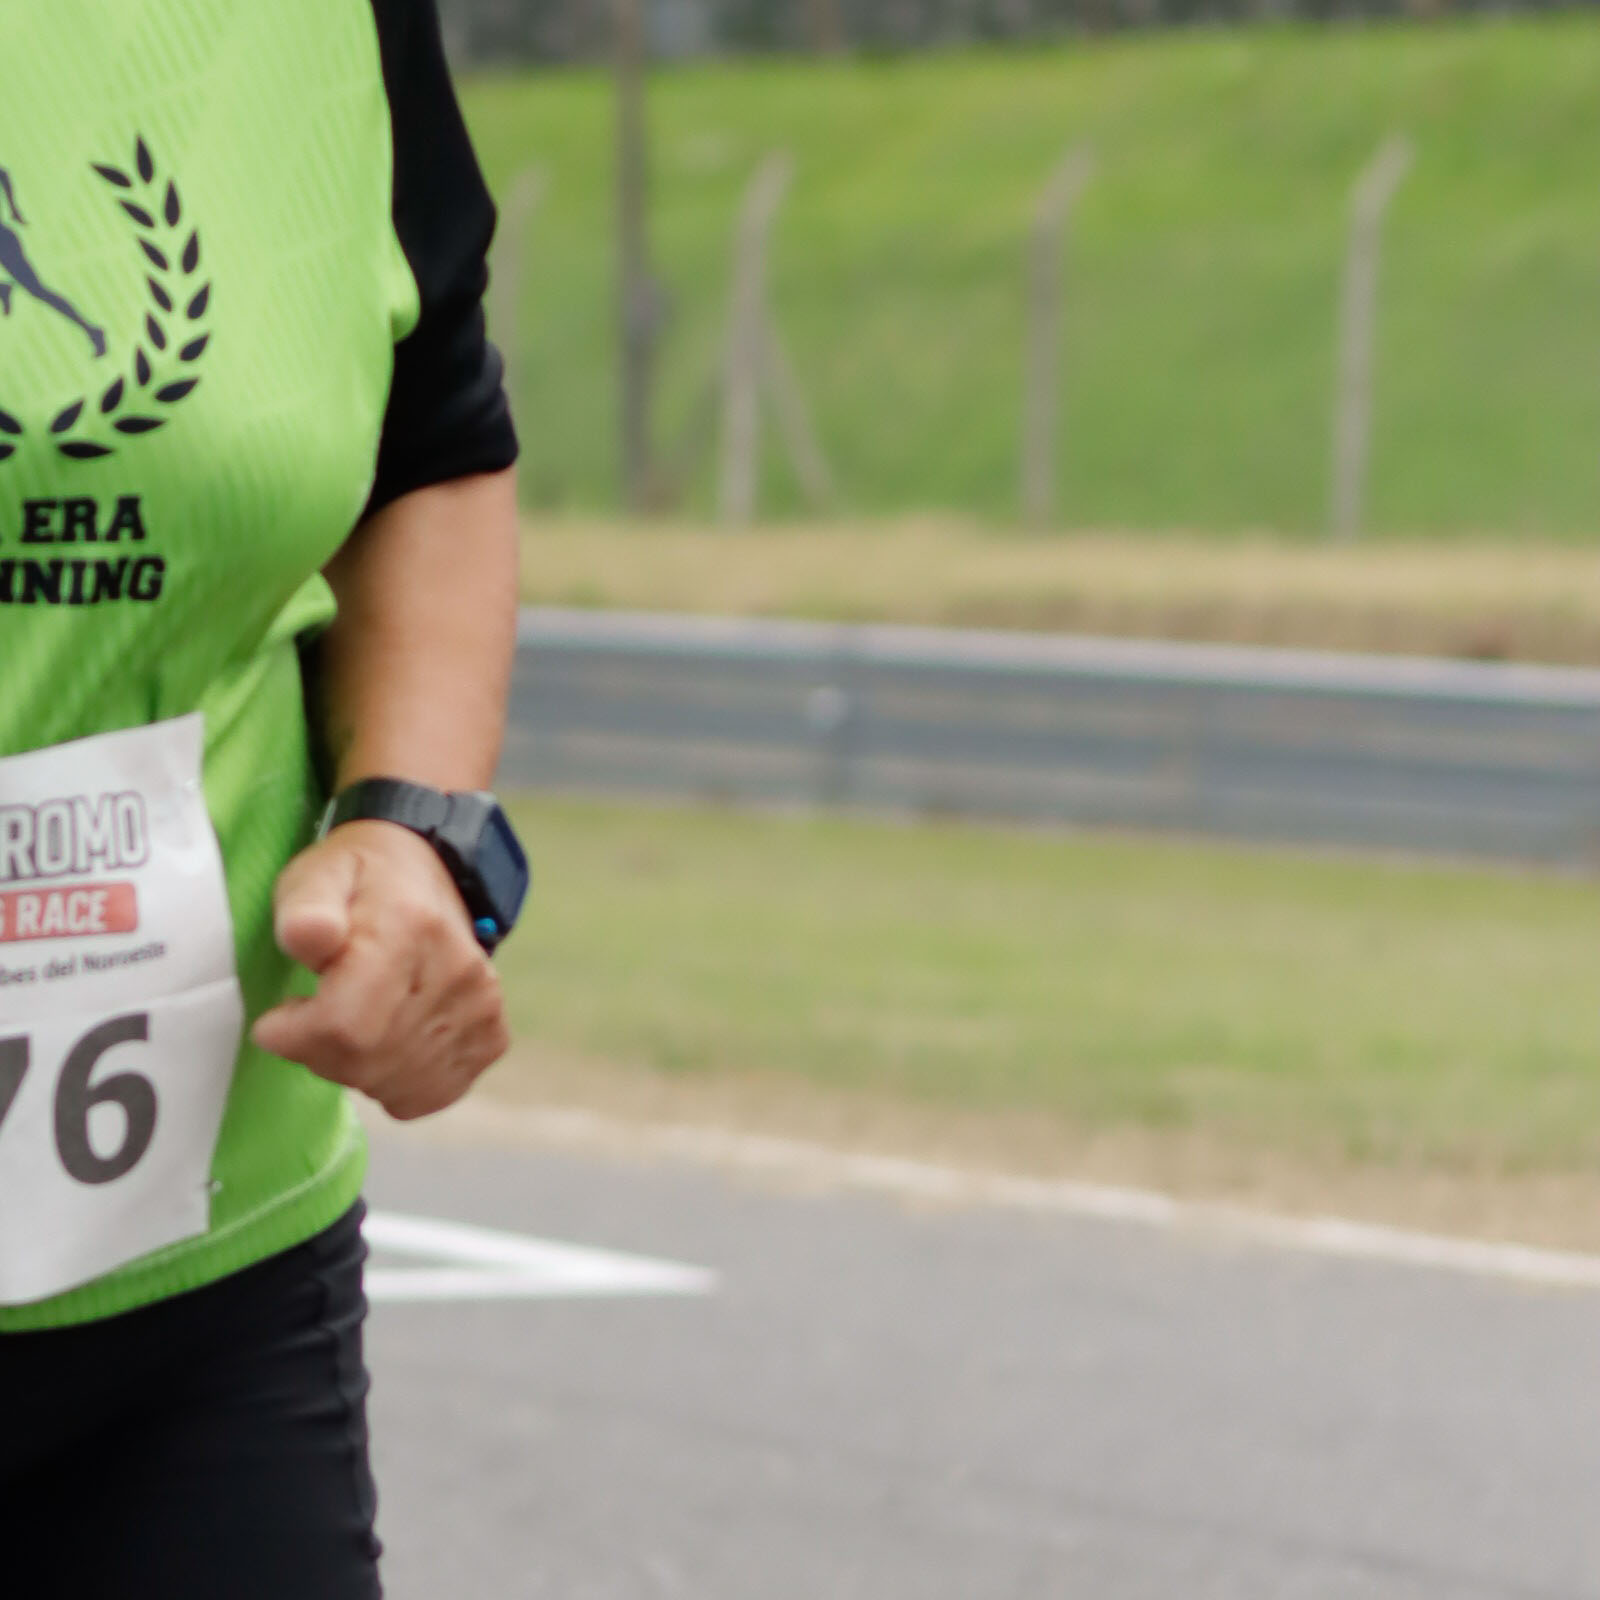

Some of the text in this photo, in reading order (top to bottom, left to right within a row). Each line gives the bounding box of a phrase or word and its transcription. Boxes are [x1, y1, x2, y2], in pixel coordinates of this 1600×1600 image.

[19, 496, 146, 543] ERA
[16, 889, 110, 938] RACE
[43, 953, 77, 980] del
